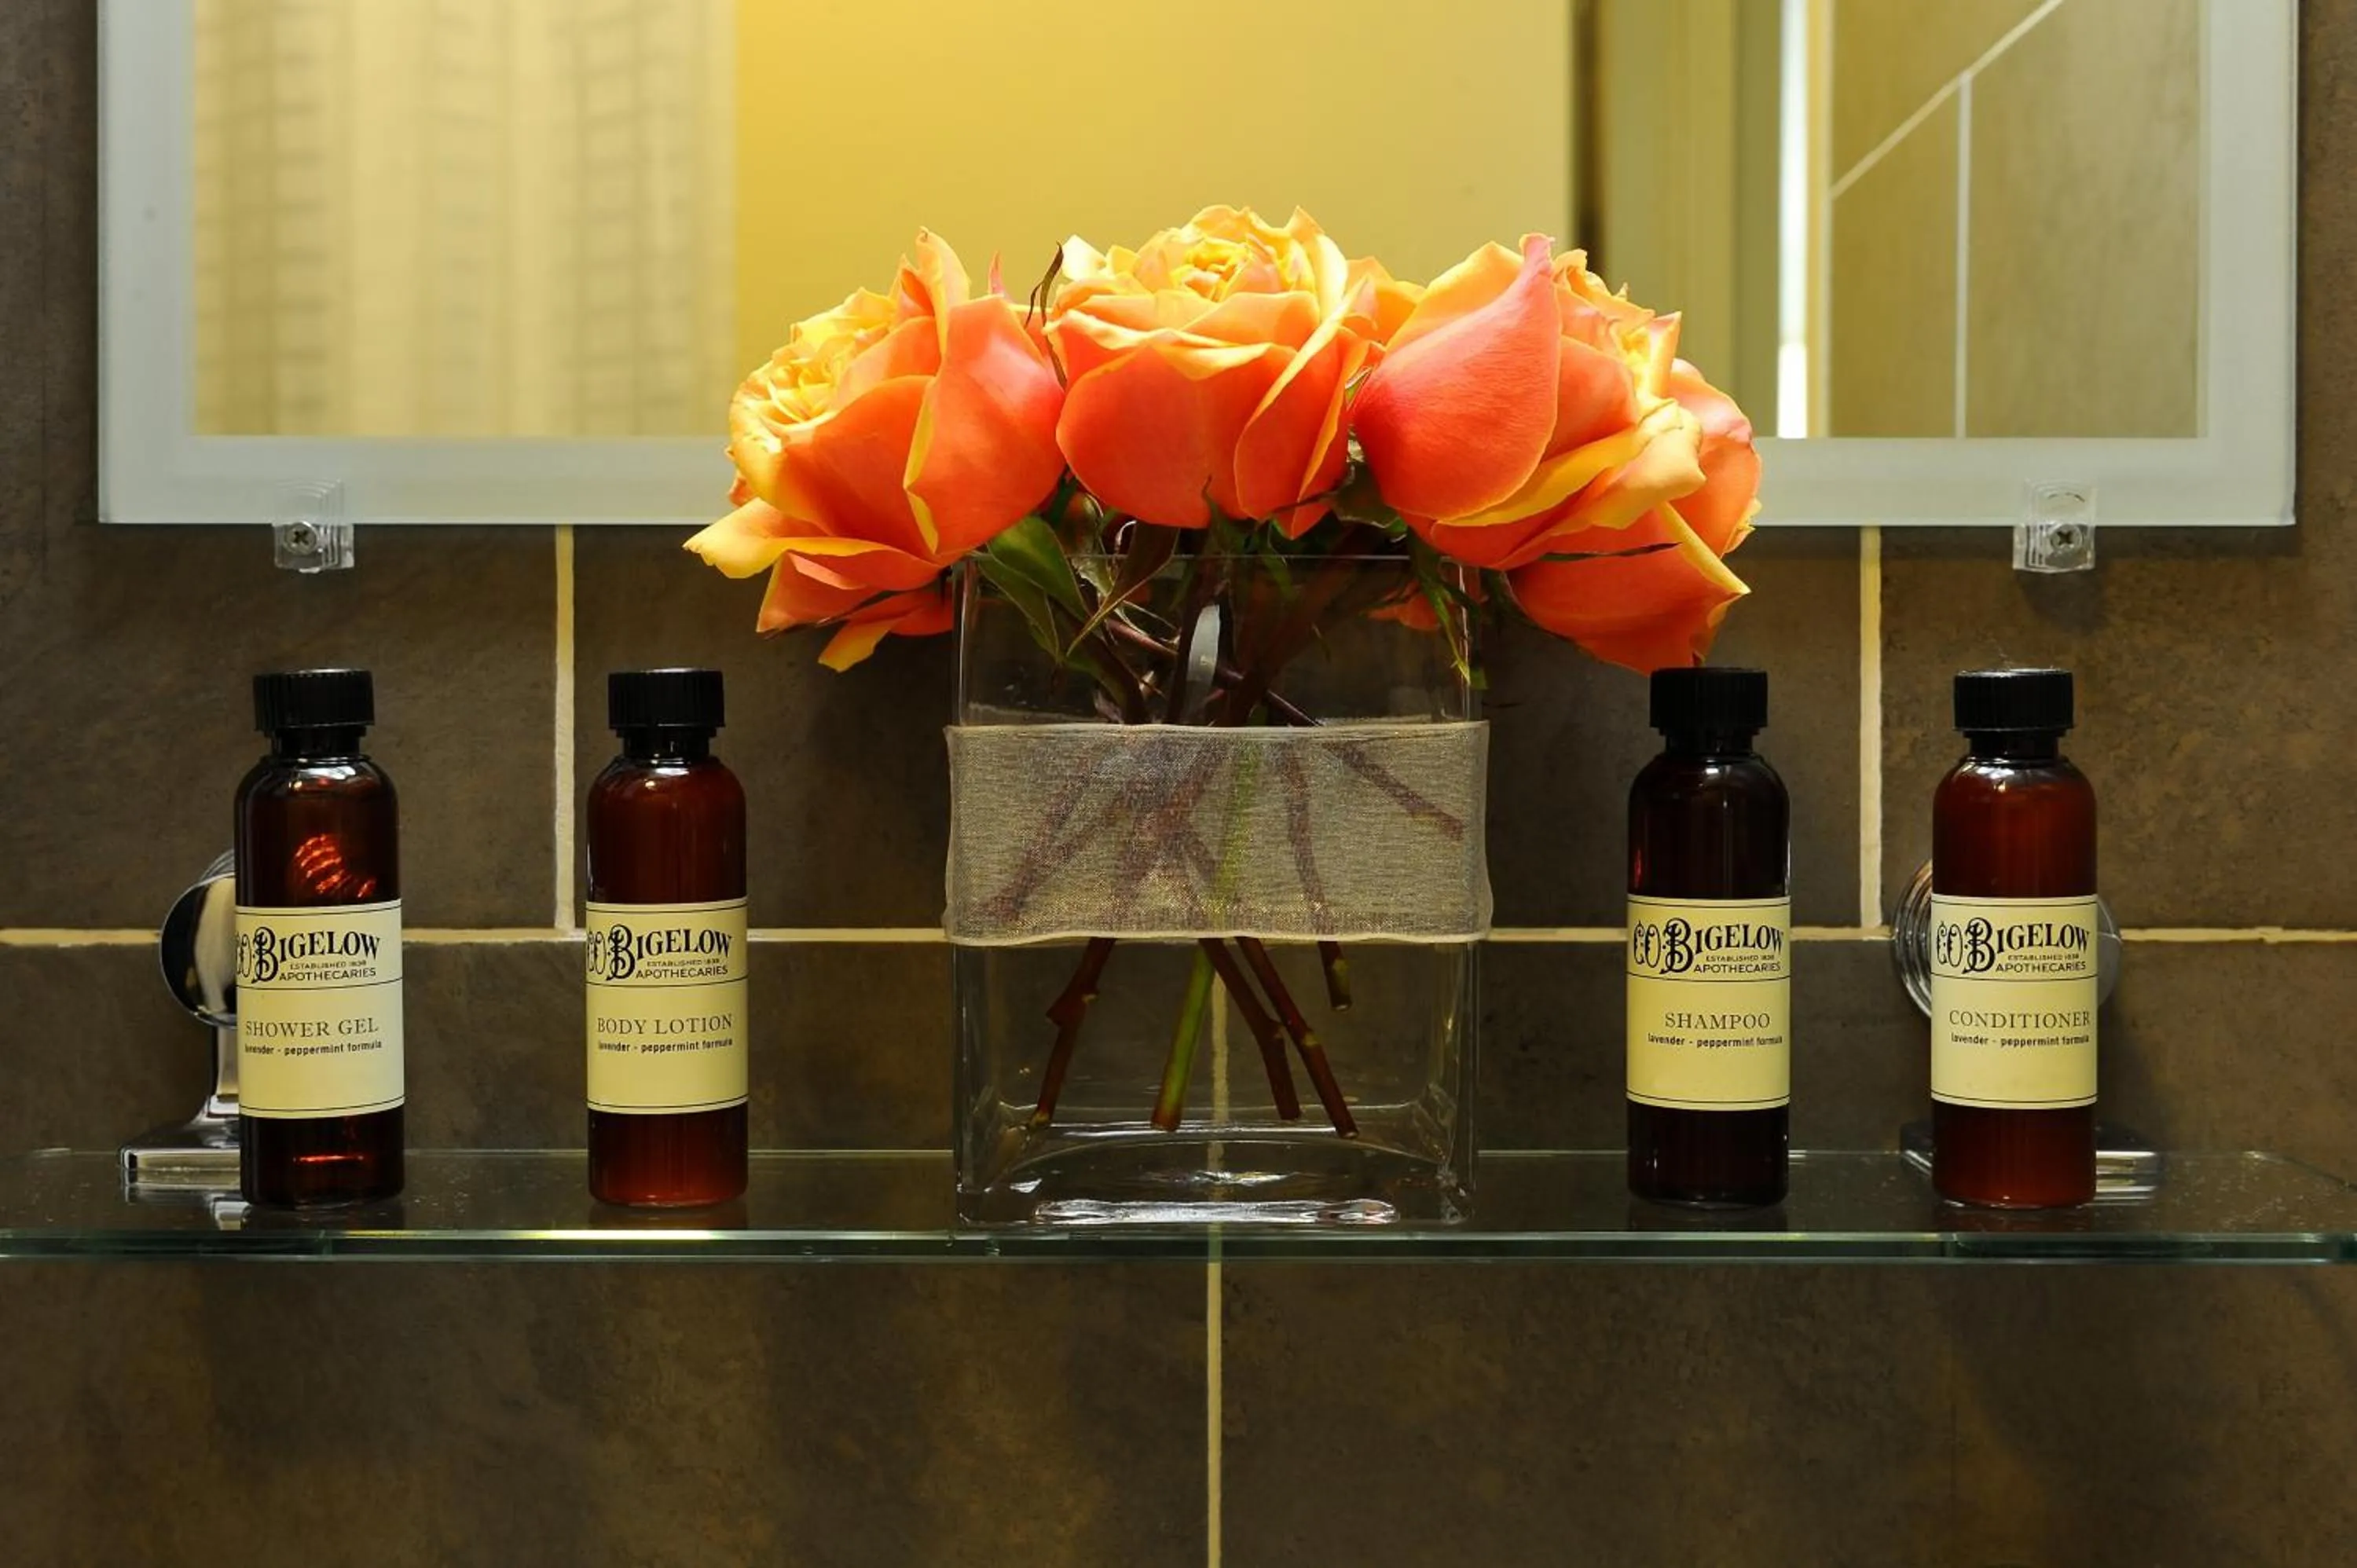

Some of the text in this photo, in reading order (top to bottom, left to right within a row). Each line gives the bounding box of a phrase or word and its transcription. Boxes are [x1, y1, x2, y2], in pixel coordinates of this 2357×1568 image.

[605, 924, 733, 980] BIGELOW
[1659, 918, 1784, 974] BIGELOW
[1961, 918, 2090, 973] BIGELOW
[251, 926, 381, 984] BIGELOW
[279, 968, 376, 981] APOTHECARIES
[636, 965, 728, 979] APOTHECARIES
[1693, 962, 1781, 973] APOTHECARIES
[1995, 962, 2086, 973] APOTHECARIES
[597, 1013, 733, 1035] BODY LOTION
[1665, 1013, 1771, 1029] SHAMPOO
[1949, 1010, 2090, 1028] CONDITIONER
[245, 1017, 379, 1037] SHOWER GEL
[640, 1041, 699, 1053] peppermint
[1696, 1037, 1754, 1048] peppermint
[2000, 1036, 2059, 1047] peppermint
[284, 1043, 344, 1056] peppermint
